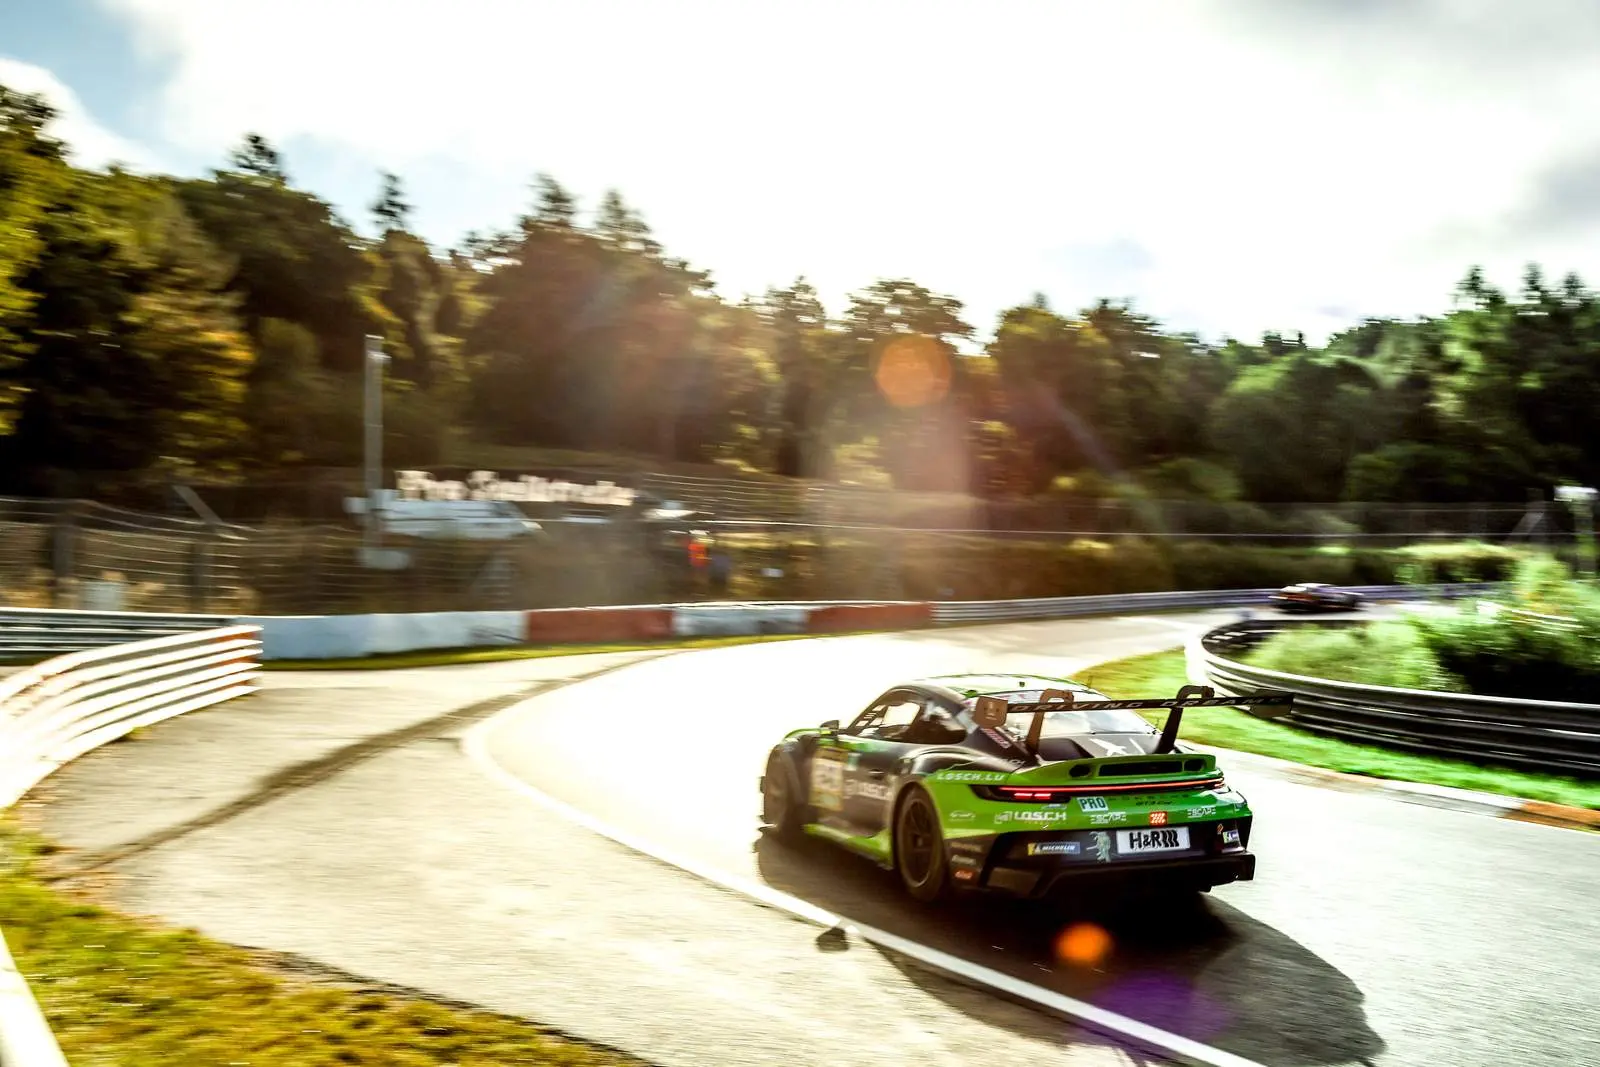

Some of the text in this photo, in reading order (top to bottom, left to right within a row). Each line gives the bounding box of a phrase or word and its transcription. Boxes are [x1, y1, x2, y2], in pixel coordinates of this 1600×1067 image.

[1010, 701, 1144, 713] DRIVING
[936, 772, 1006, 781] LOSCH.LU
[1079, 797, 1106, 810] PRO
[1014, 811, 1067, 821] LOSCH
